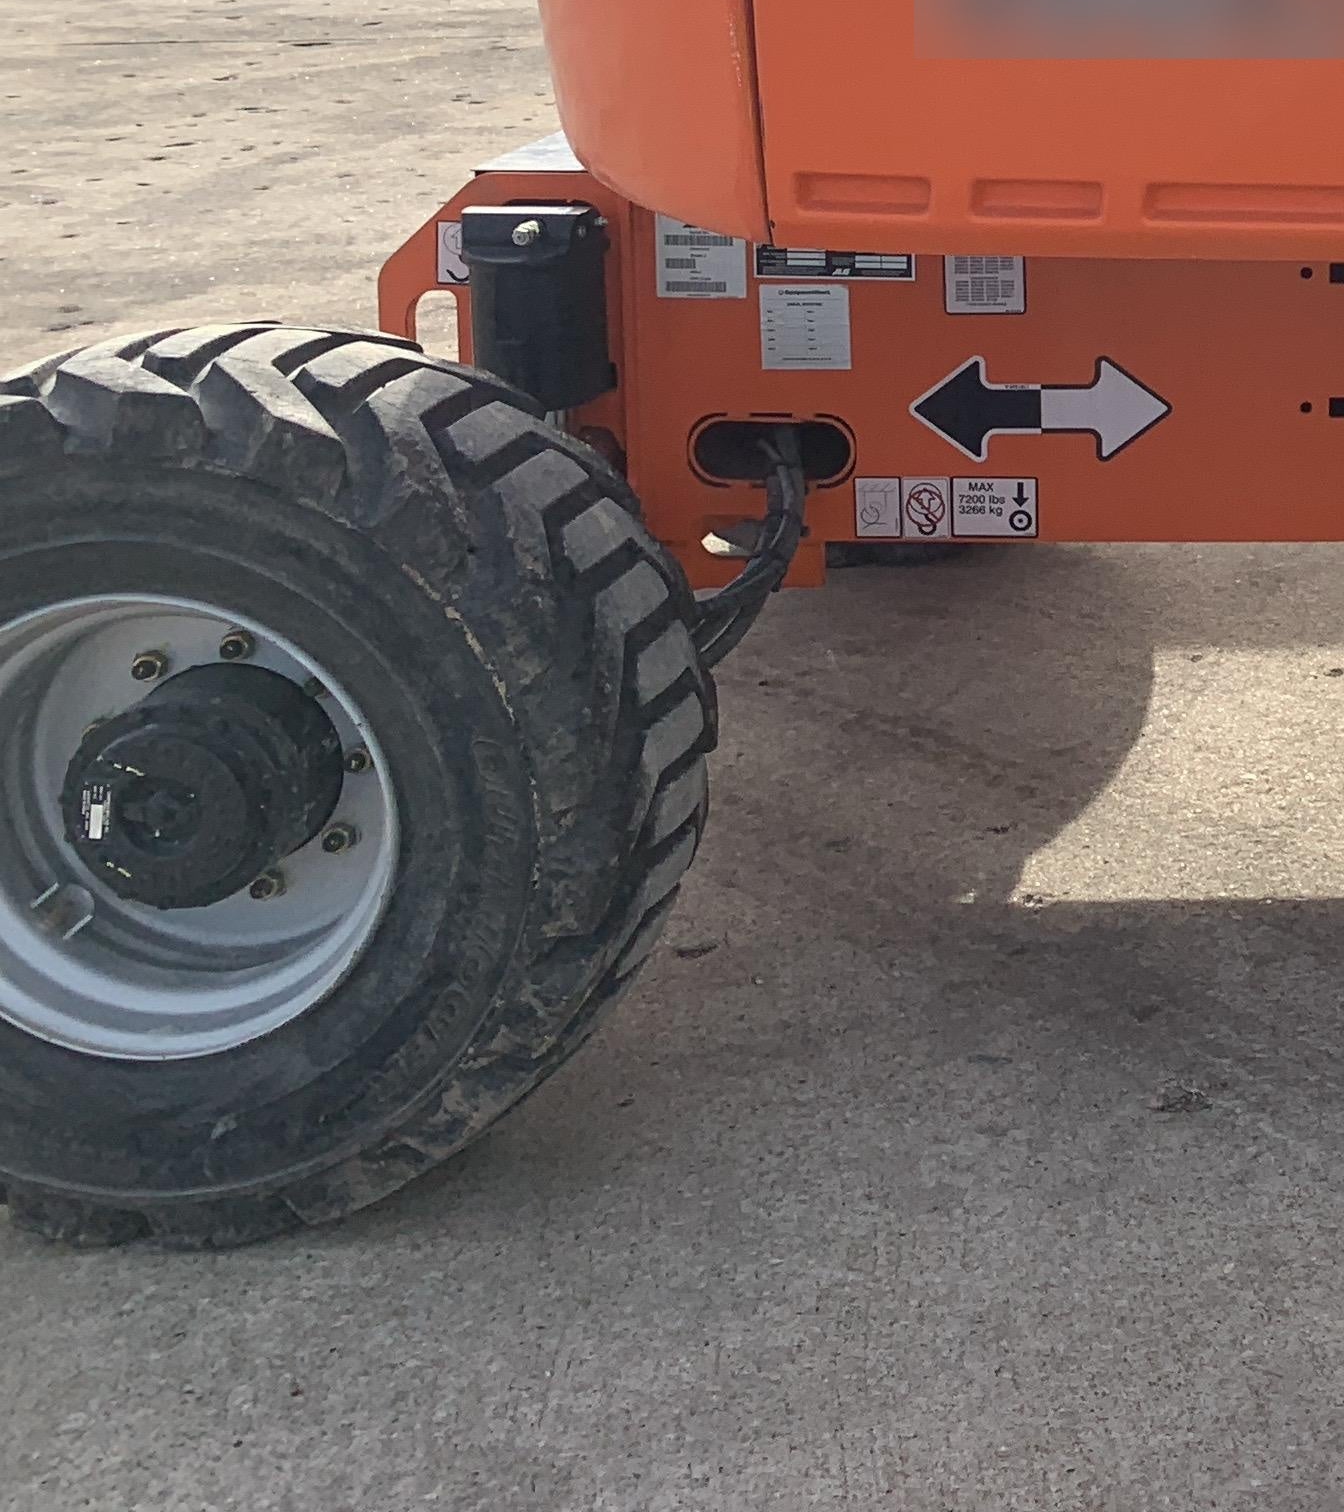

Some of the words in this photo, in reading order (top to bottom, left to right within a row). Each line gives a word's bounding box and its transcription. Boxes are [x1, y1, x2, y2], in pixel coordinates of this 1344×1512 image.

[968, 481, 994, 492] MAX
[959, 494, 985, 504] 7200
[988, 494, 1006, 504] lbs
[988, 505, 1003, 517] kg
